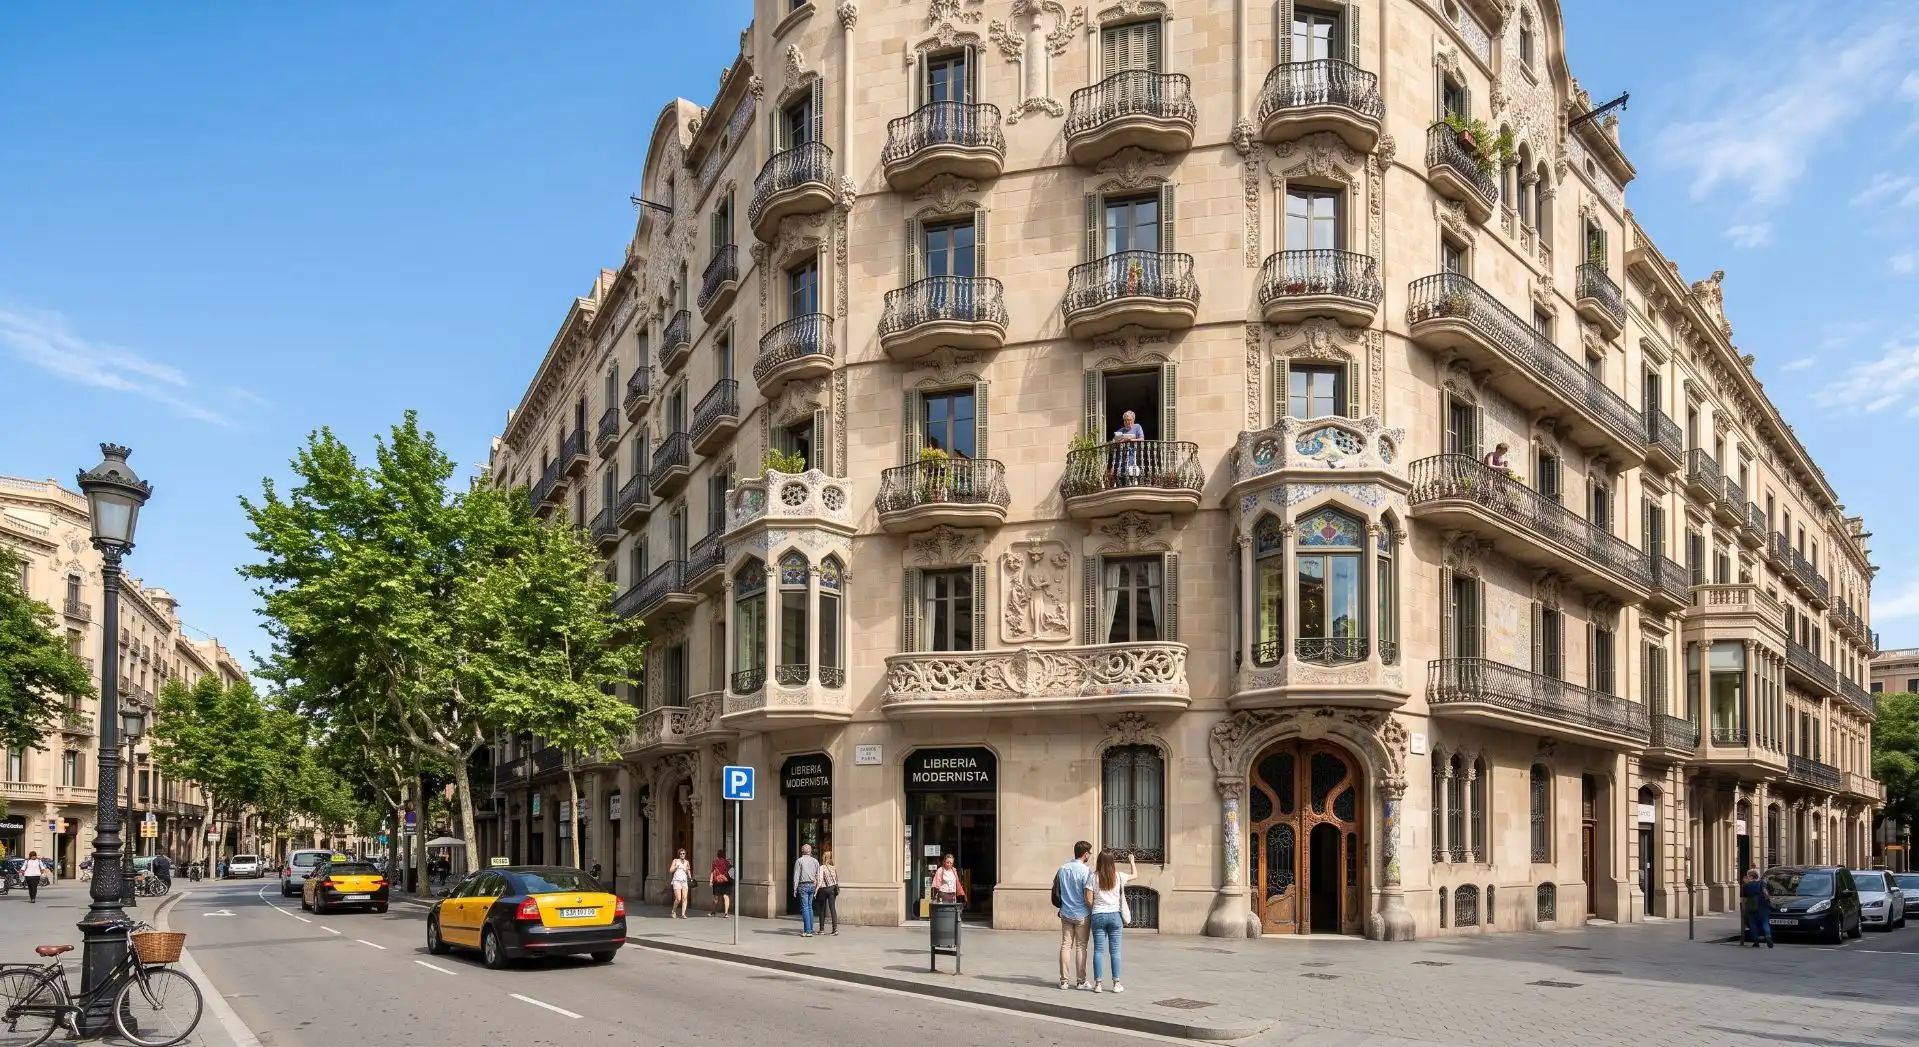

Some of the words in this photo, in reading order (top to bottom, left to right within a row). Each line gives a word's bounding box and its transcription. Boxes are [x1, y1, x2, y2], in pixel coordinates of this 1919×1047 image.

[923, 757, 977, 769] LIBRERIA
[791, 764, 822, 776] LIBRERIA
[731, 770, 748, 795] P
[786, 776, 829, 788] MODERNISTA
[912, 771, 989, 783] MODERNISTA
